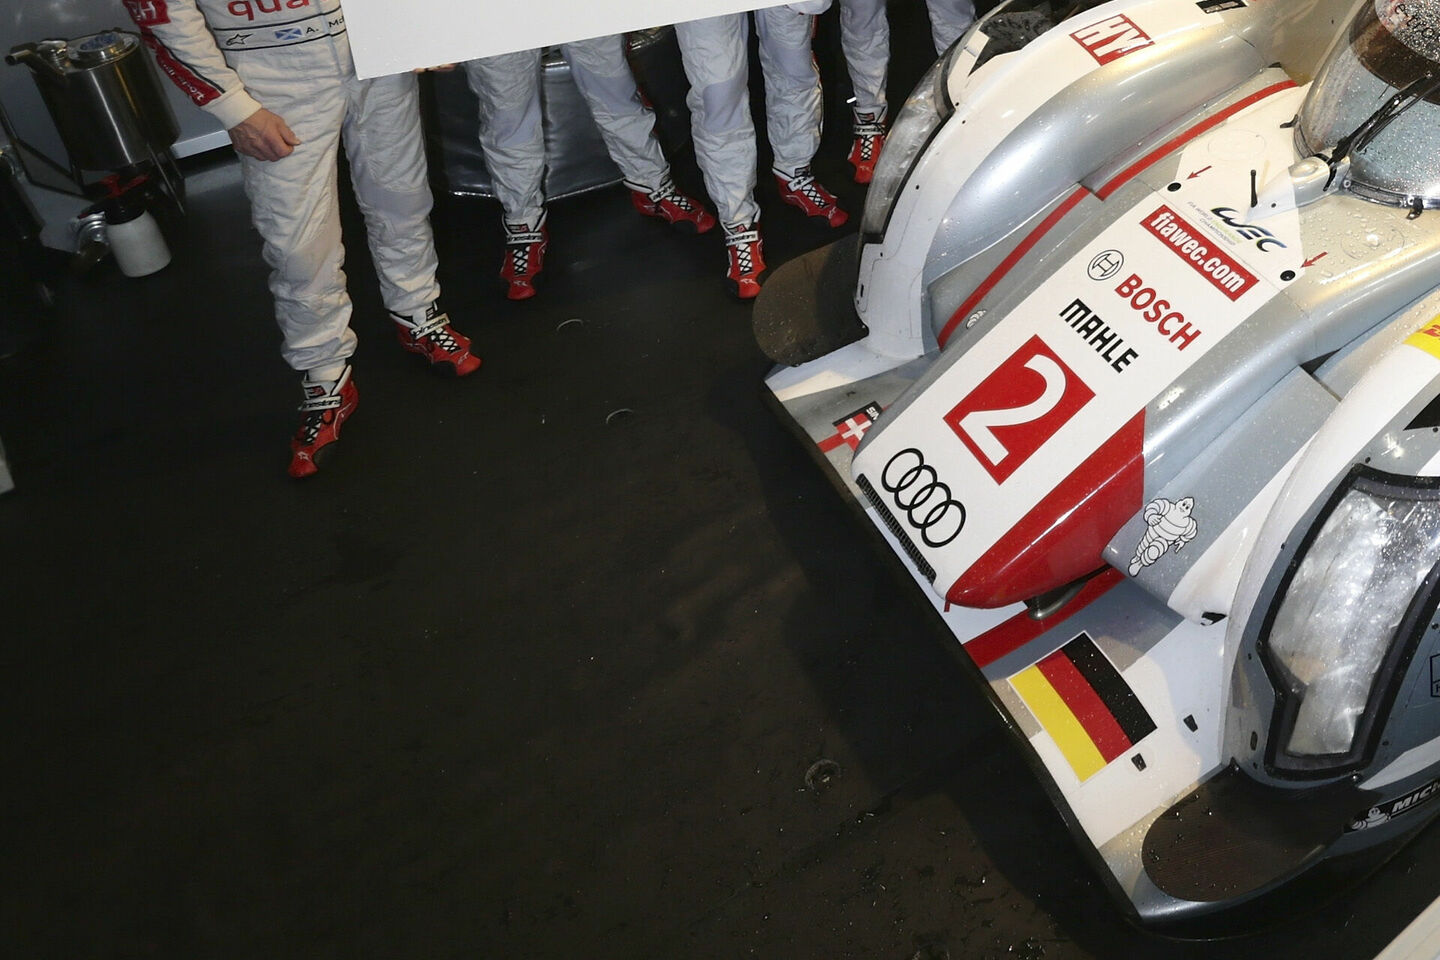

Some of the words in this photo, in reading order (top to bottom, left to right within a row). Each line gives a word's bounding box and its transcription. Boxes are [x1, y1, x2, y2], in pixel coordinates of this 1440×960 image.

[305, 26, 319, 35] A.
[1074, 13, 1153, 59] HY
[1150, 211, 1246, 294] fiawec.com
[1210, 206, 1288, 252] WEC
[1059, 297, 1139, 374] MAHLE
[1115, 273, 1202, 351] BOSCH
[959, 354, 1067, 468] 2
